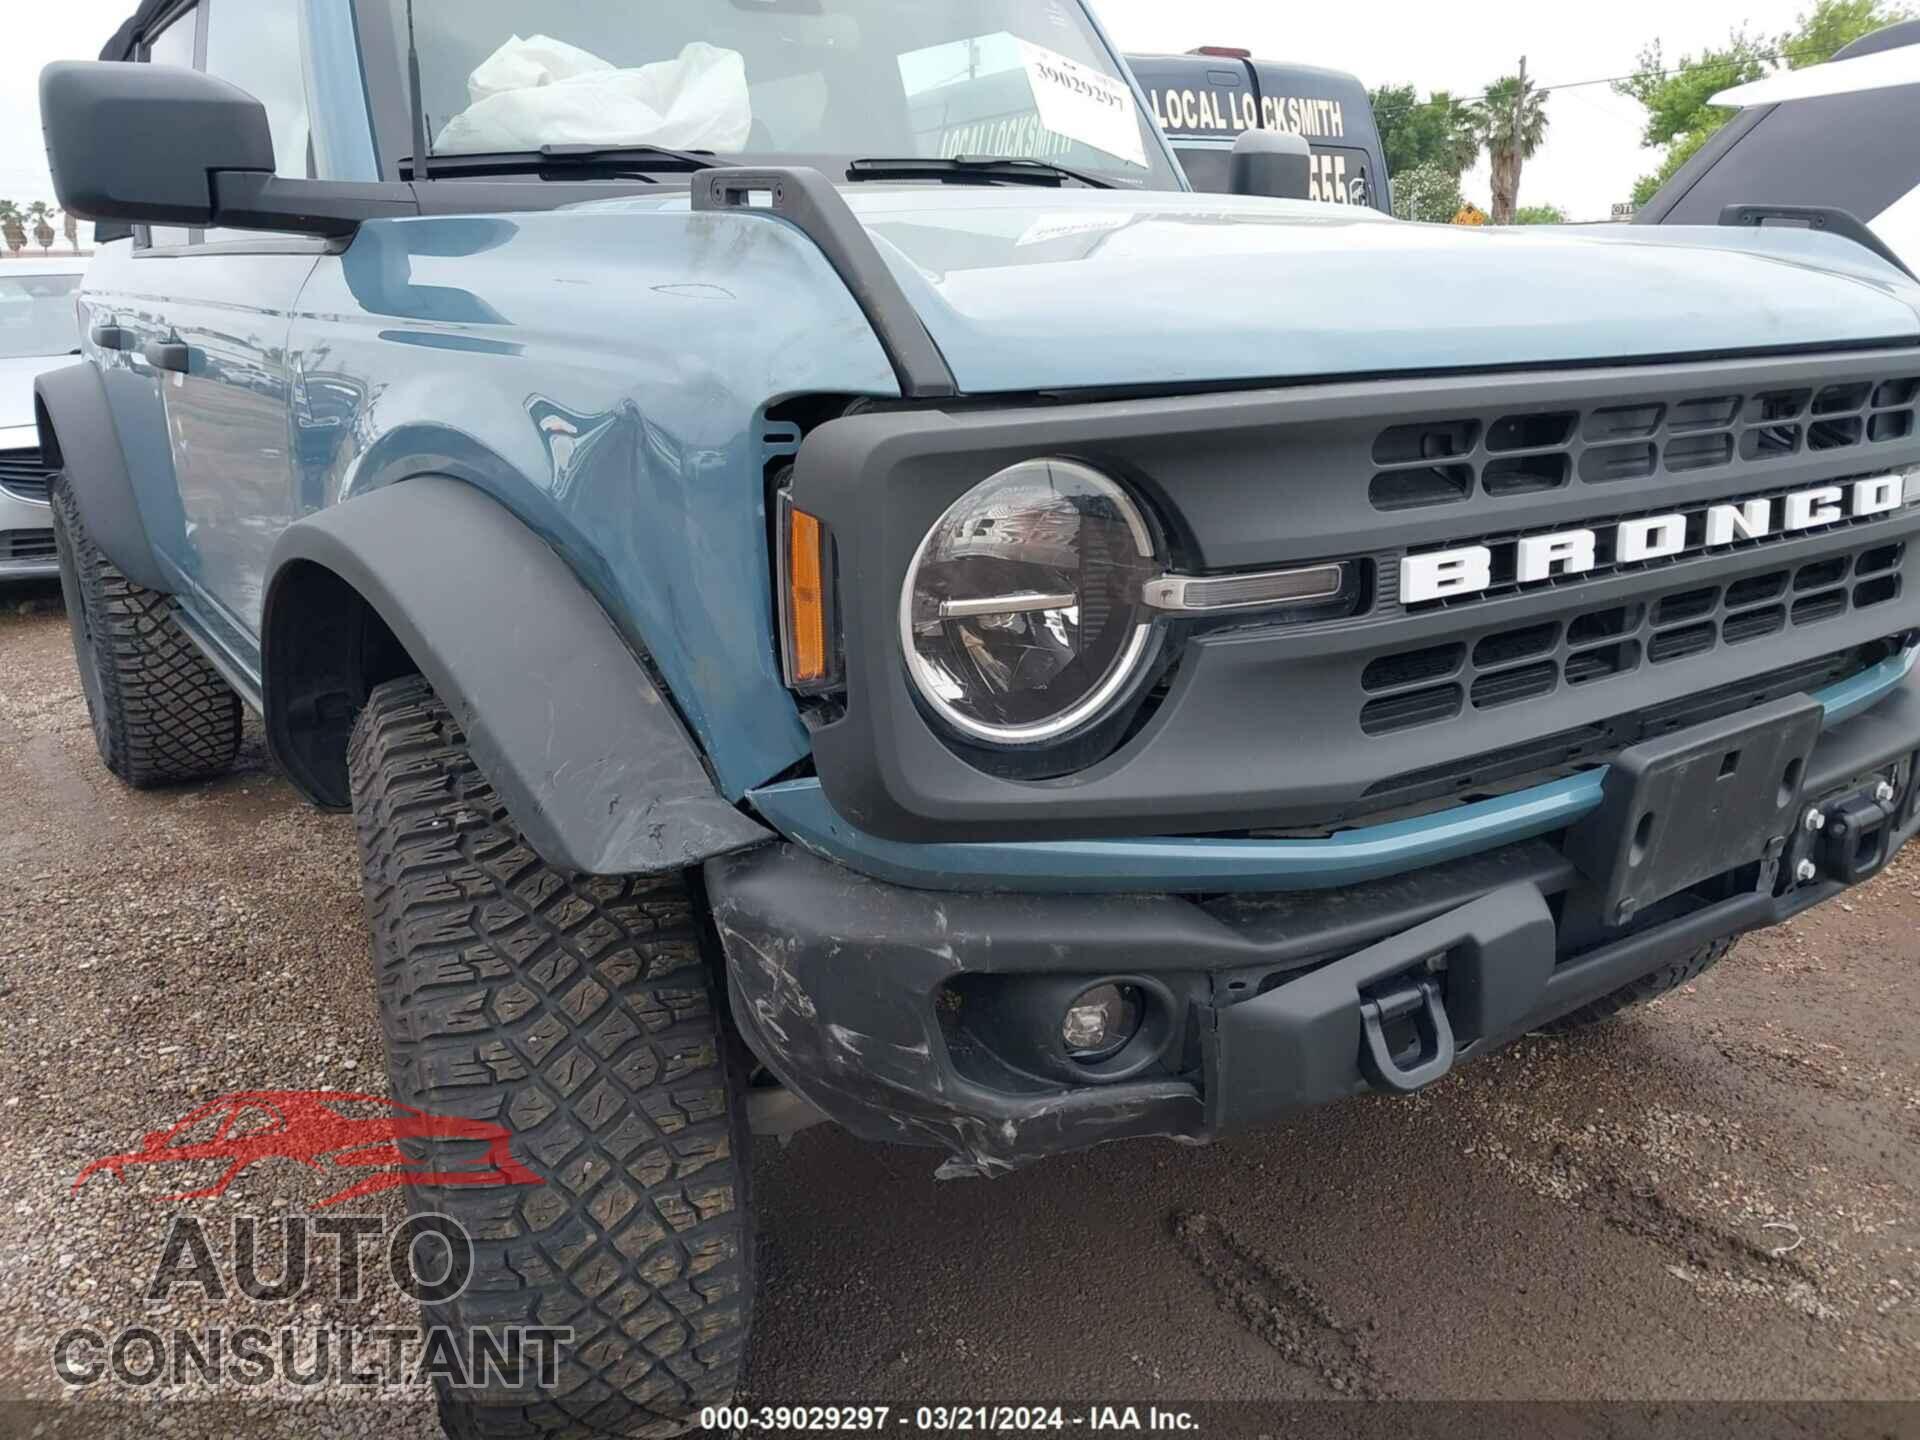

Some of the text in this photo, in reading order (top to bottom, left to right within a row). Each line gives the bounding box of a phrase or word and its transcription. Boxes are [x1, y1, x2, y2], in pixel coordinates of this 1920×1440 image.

[1034, 62, 1123, 112] 39029297
[1151, 88, 1344, 137] LOCAL LOCKSMITH
[1399, 474, 1903, 604] BRONCO
